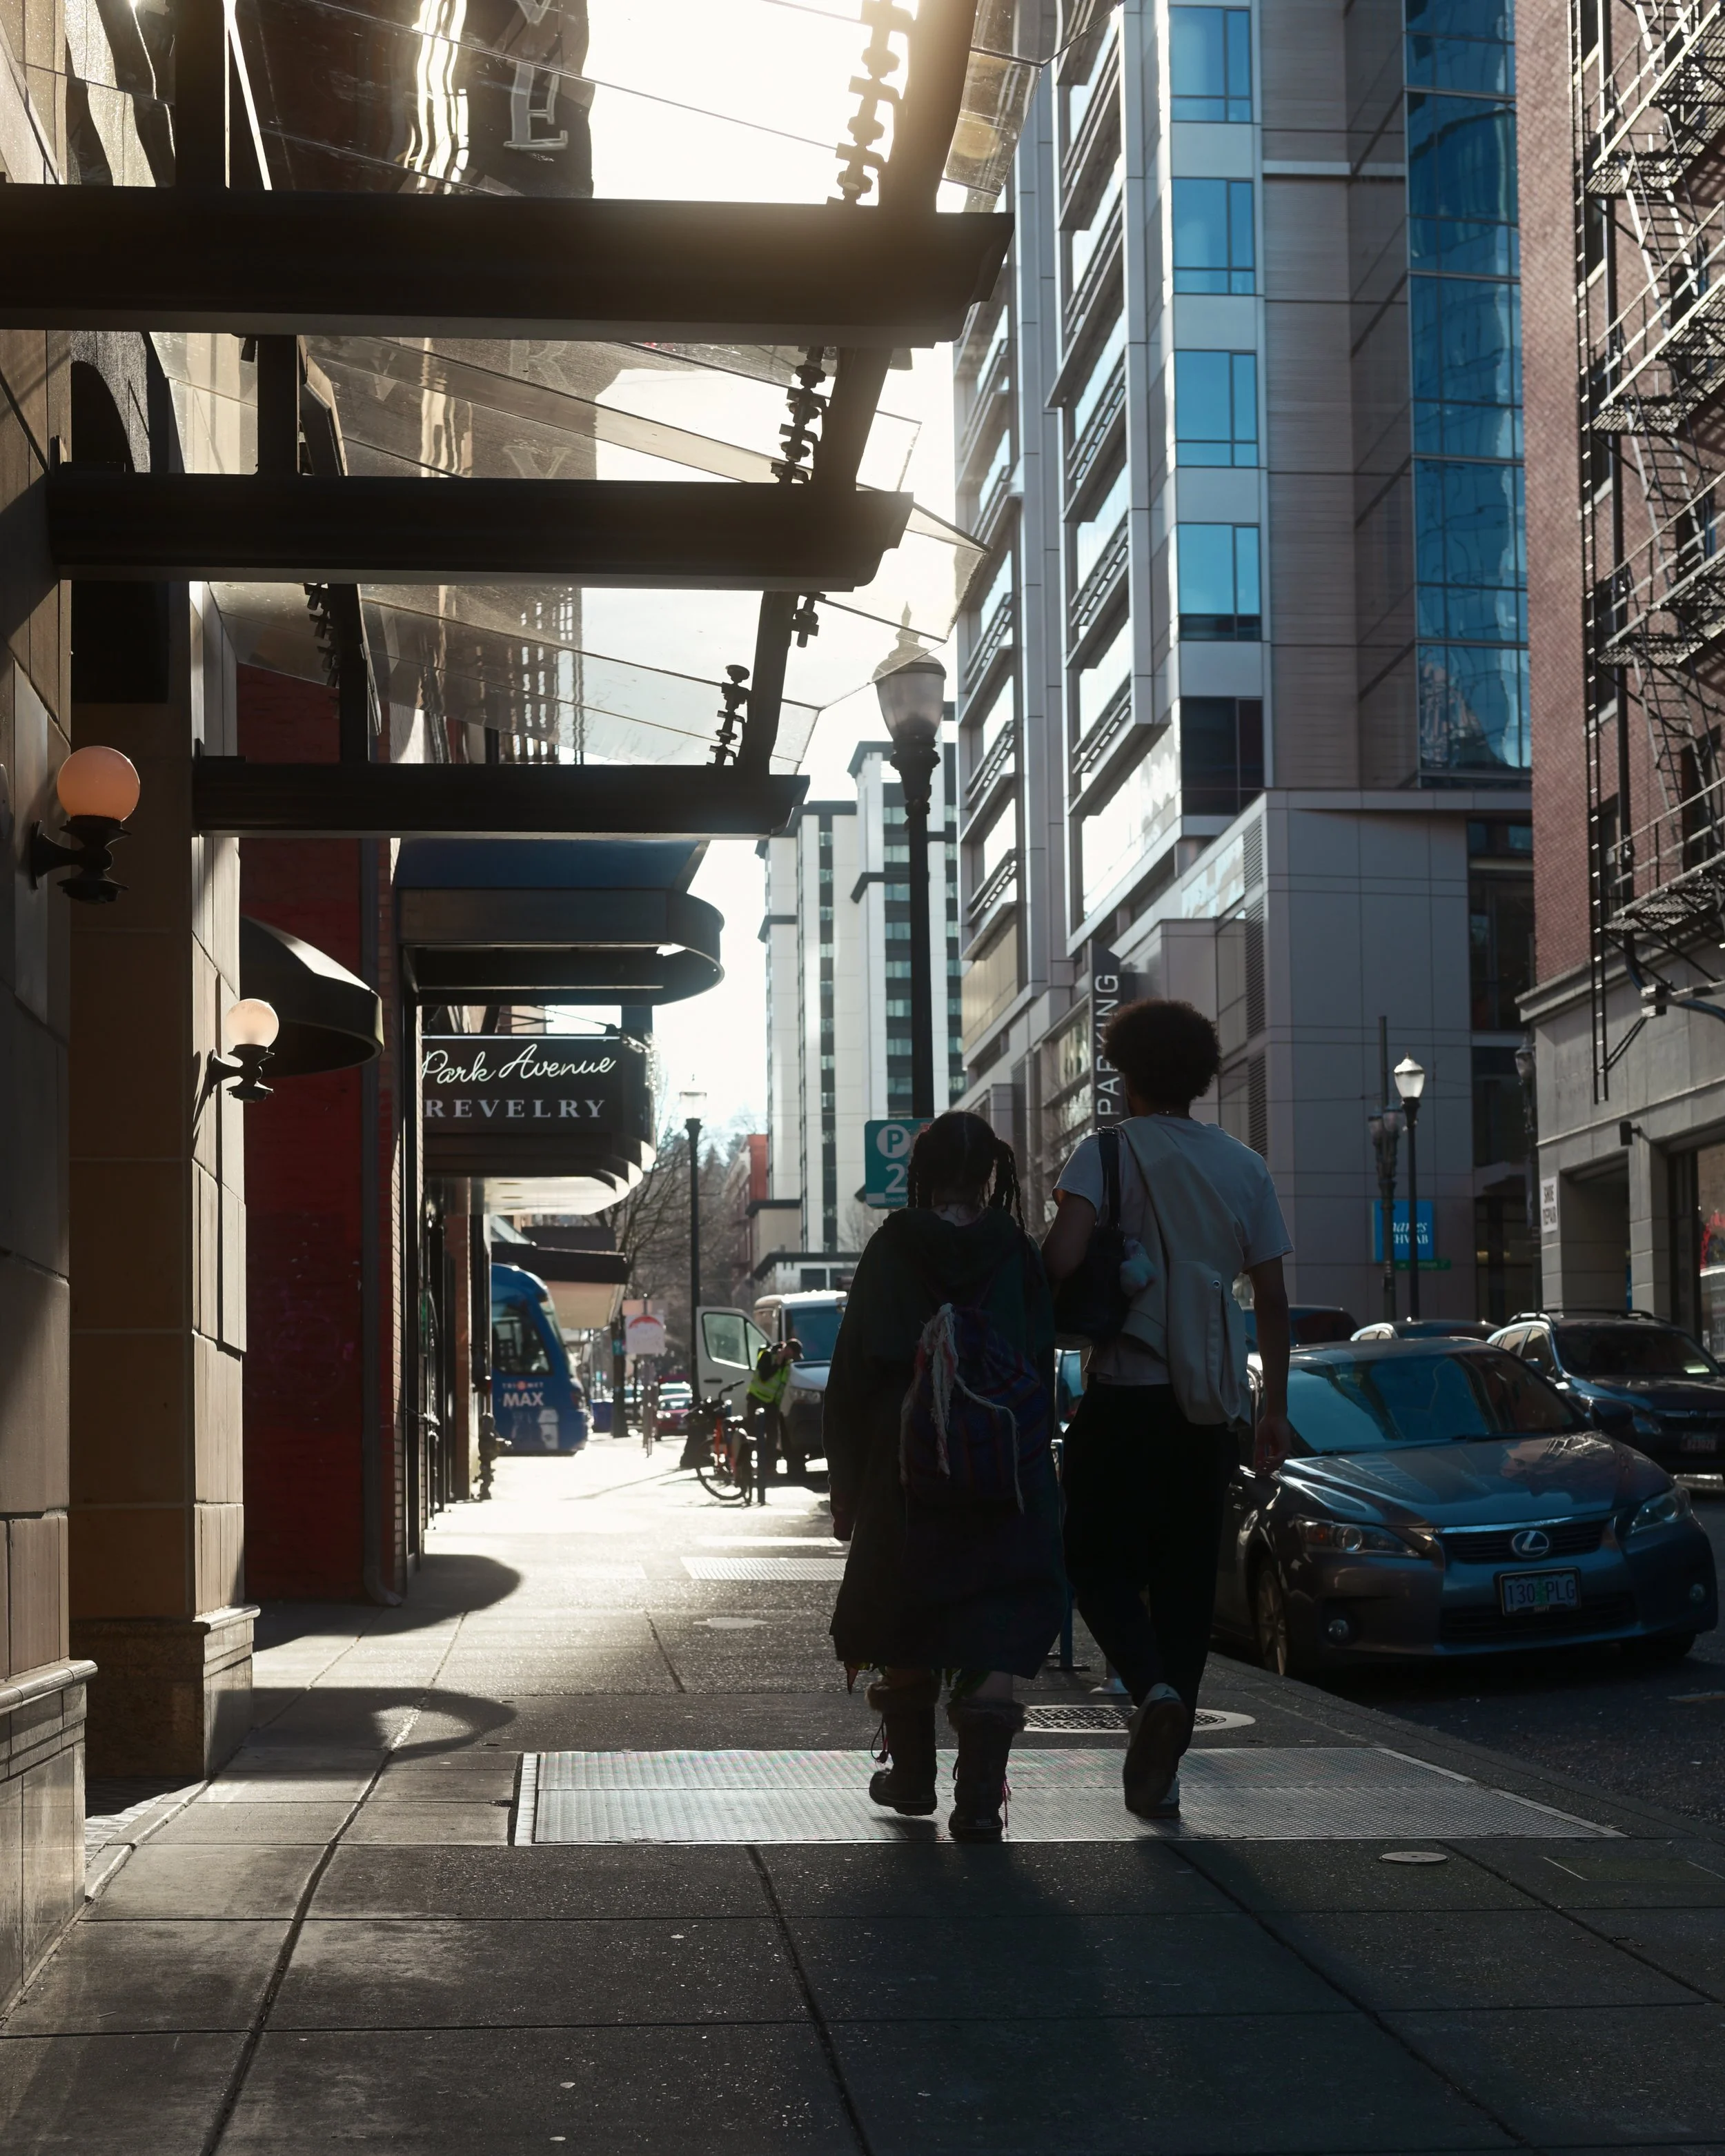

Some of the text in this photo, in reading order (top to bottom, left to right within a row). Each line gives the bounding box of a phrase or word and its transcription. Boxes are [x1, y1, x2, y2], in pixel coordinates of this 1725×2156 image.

[422, 1043, 616, 1085] Park Avenue
[424, 1099, 605, 1118] REVELRY
[887, 1129, 903, 1153] P
[885, 1163, 907, 1194] 2
[503, 1392, 544, 1407] MAX
[1508, 1579, 1575, 1605] 130 PLG
